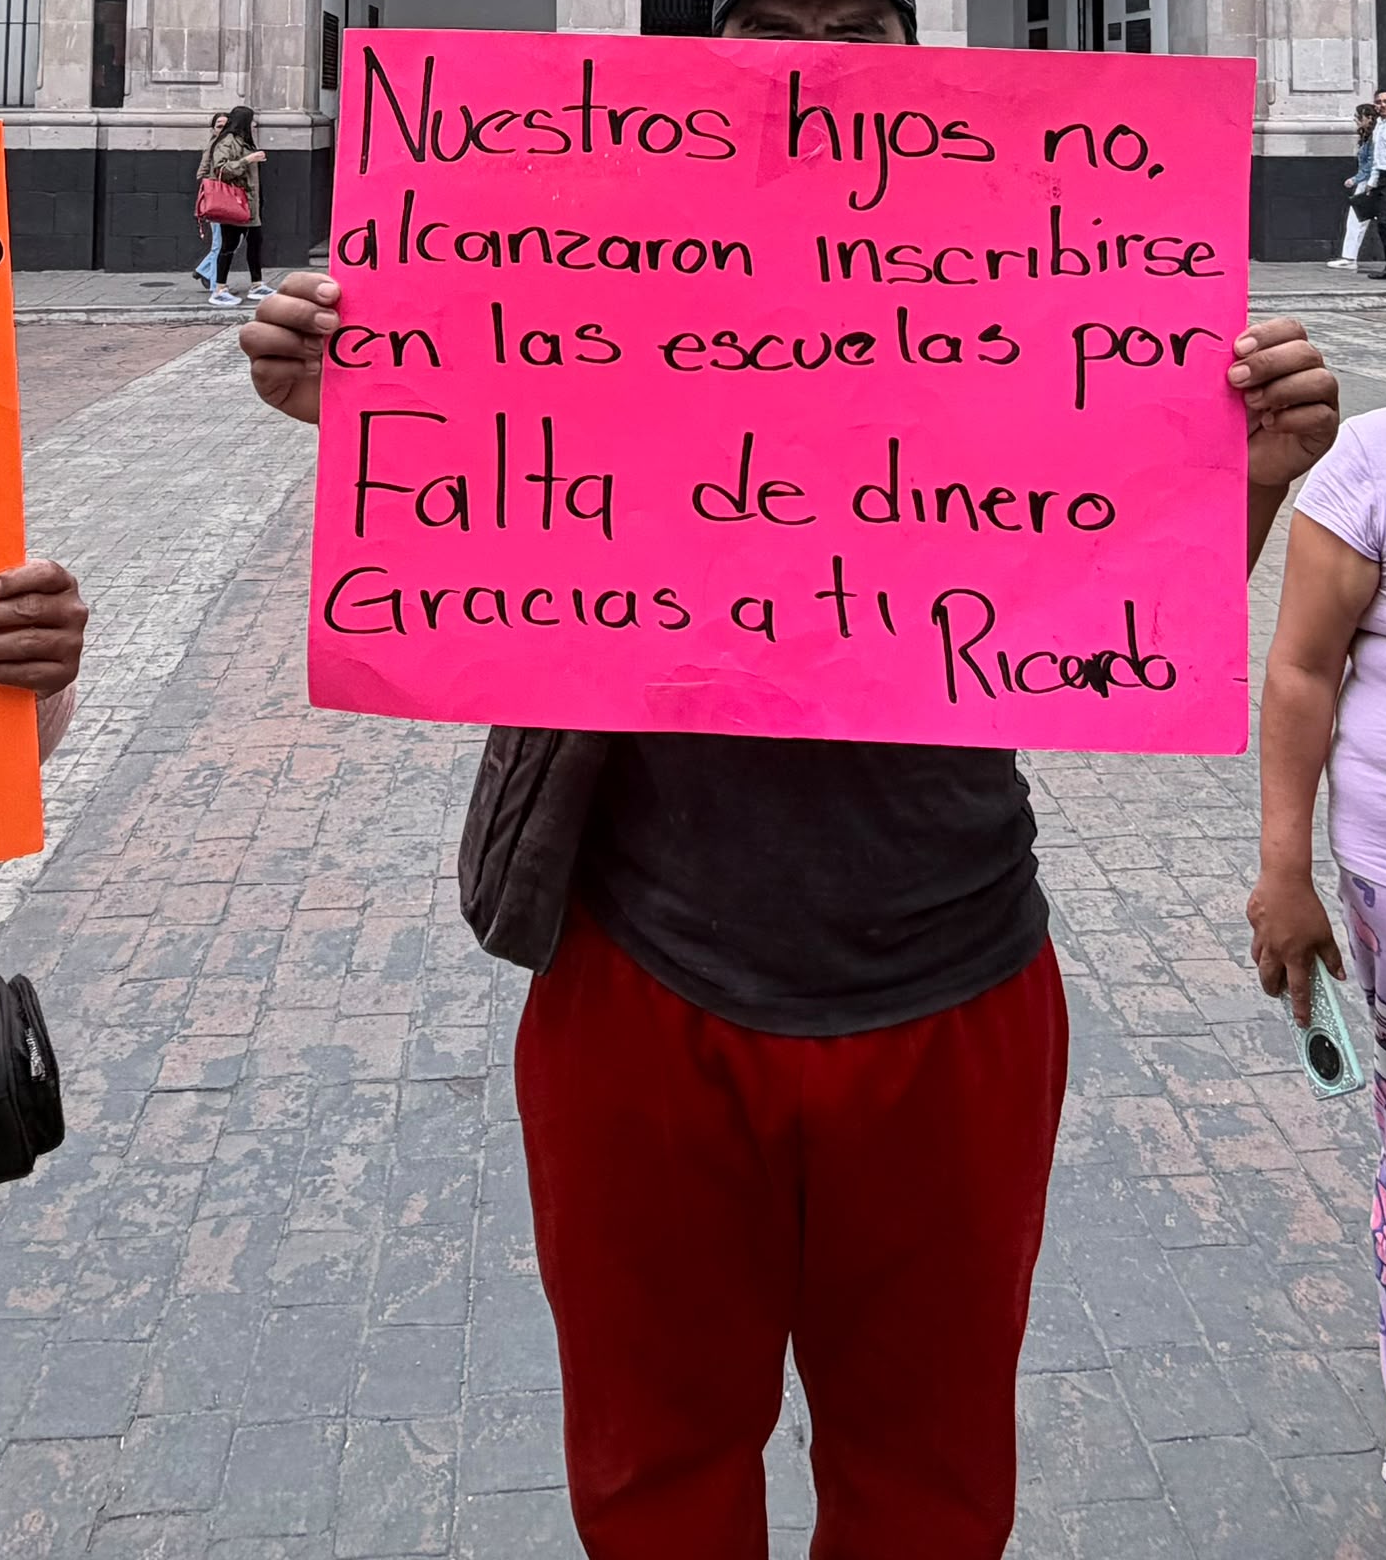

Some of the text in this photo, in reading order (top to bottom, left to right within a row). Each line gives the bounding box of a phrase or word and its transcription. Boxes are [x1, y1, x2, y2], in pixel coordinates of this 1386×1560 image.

[358, 44, 738, 175] Nuestros
[787, 69, 997, 212] hijos
[336, 188, 753, 278] alcanzaron
[326, 300, 1222, 410] en las escuelas por
[355, 410, 1116, 542] Falta de dinero
[322, 554, 1178, 705] Gracias a ti Ricardo
